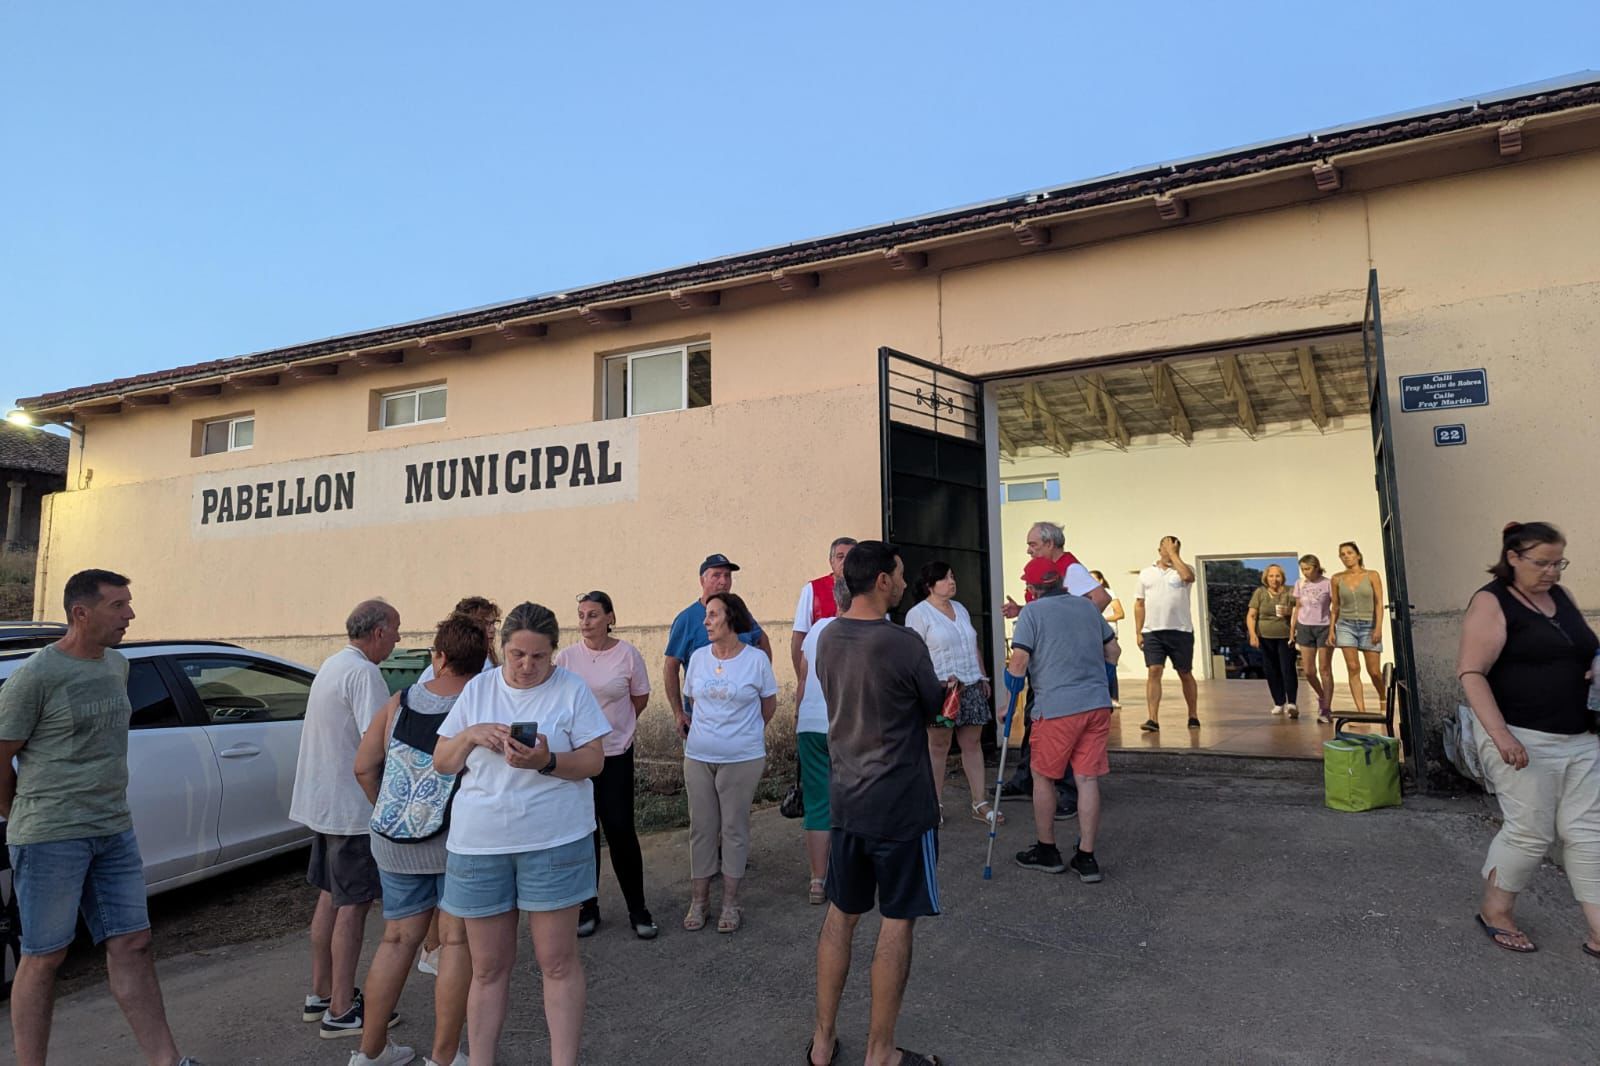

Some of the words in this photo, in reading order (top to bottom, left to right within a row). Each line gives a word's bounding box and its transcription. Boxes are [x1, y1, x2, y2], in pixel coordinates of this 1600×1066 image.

[1441, 397, 1472, 406] Martín
[1440, 430, 1460, 440] 22
[201, 471, 356, 524] PABELLON
[405, 440, 622, 504] MUNICIPAL
